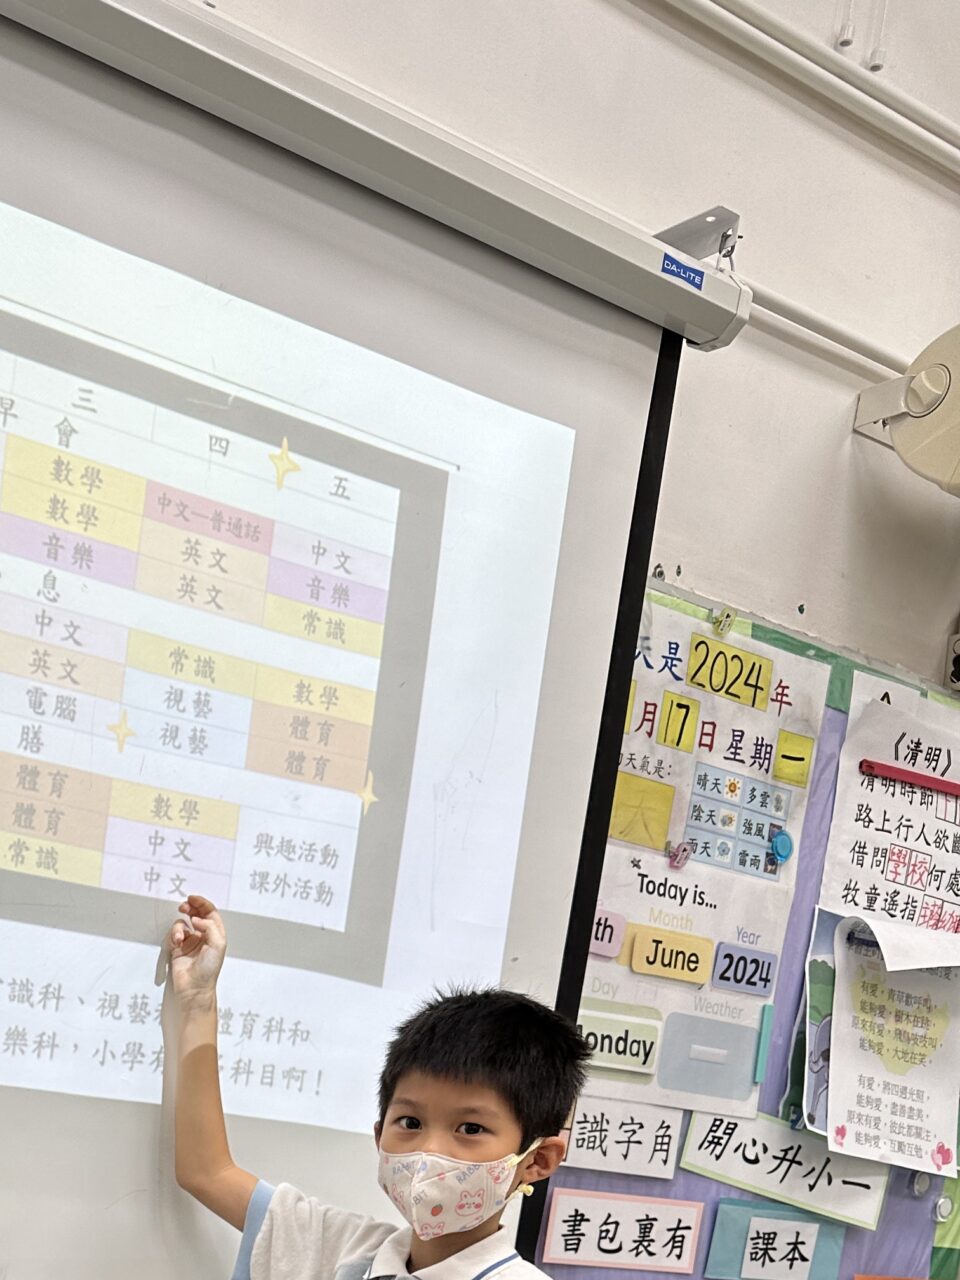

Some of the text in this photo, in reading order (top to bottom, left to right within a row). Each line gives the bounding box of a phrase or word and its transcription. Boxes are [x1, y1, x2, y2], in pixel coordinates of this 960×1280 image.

[663, 259, 702, 286] DA-LITE
[71, 386, 100, 415] 三
[207, 432, 231, 458] 四
[48, 455, 105, 496] 數學
[327, 475, 352, 502] 五
[44, 493, 101, 533] 數學
[42, 532, 96, 572] 音樂
[179, 537, 231, 575] 英文
[310, 540, 354, 576] 中文
[176, 573, 226, 613] 英文
[305, 573, 352, 610] 音樂
[33, 608, 85, 648] 中文
[300, 609, 348, 646] 常識
[27, 647, 81, 686] 英文
[168, 645, 218, 685] 常識
[25, 686, 79, 725] 電腦
[162, 684, 215, 722] 視藝
[292, 679, 341, 713] 數學
[158, 720, 210, 758] 視藝
[287, 713, 337, 749] 體育
[15, 762, 70, 801] 體育
[283, 748, 332, 783] 體育
[696, 772, 722, 796] 晴天
[149, 791, 202, 827] 數學
[747, 786, 771, 810] 多雲
[11, 801, 66, 838] 體育
[741, 817, 766, 841] 強風
[7, 837, 60, 876] 常識
[147, 829, 195, 863] 中文
[251, 831, 341, 872] 興趣活動
[738, 849, 762, 871] 雷雨
[142, 865, 189, 899] 中文
[247, 868, 336, 909] 課外活動
[637, 872, 718, 910] Today is...
[593, 916, 615, 944] th
[648, 906, 694, 932] Month
[735, 924, 761, 946] Year
[645, 938, 701, 974] June
[718, 952, 772, 990] 2024
[591, 977, 620, 999] Day
[692, 995, 745, 1020] Weather
[578, 1023, 656, 1066] onday
[574, 1111, 673, 1167] 識字角
[697, 1116, 873, 1194] 開心升小一
[560, 1207, 693, 1262] 書包裏有
[748, 1230, 811, 1271] 課本
